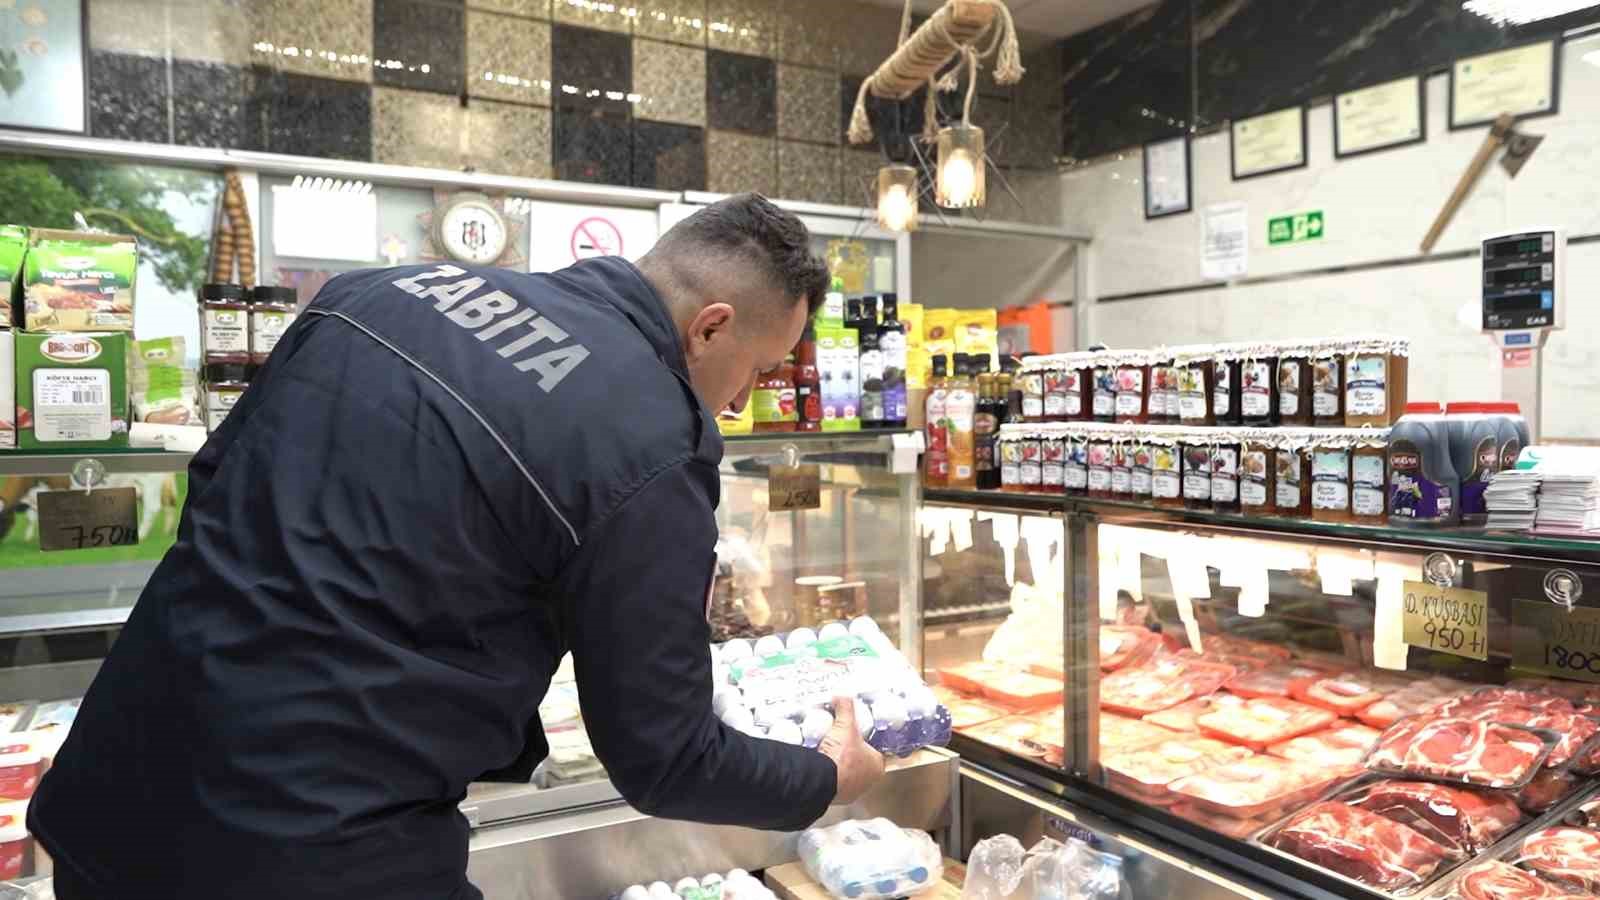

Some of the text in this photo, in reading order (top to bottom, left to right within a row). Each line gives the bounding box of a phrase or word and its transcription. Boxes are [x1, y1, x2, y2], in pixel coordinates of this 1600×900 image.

[391, 264, 591, 393] ZABITA
[1526, 317, 1547, 325] CAS
[1423, 620, 1465, 650] 950
